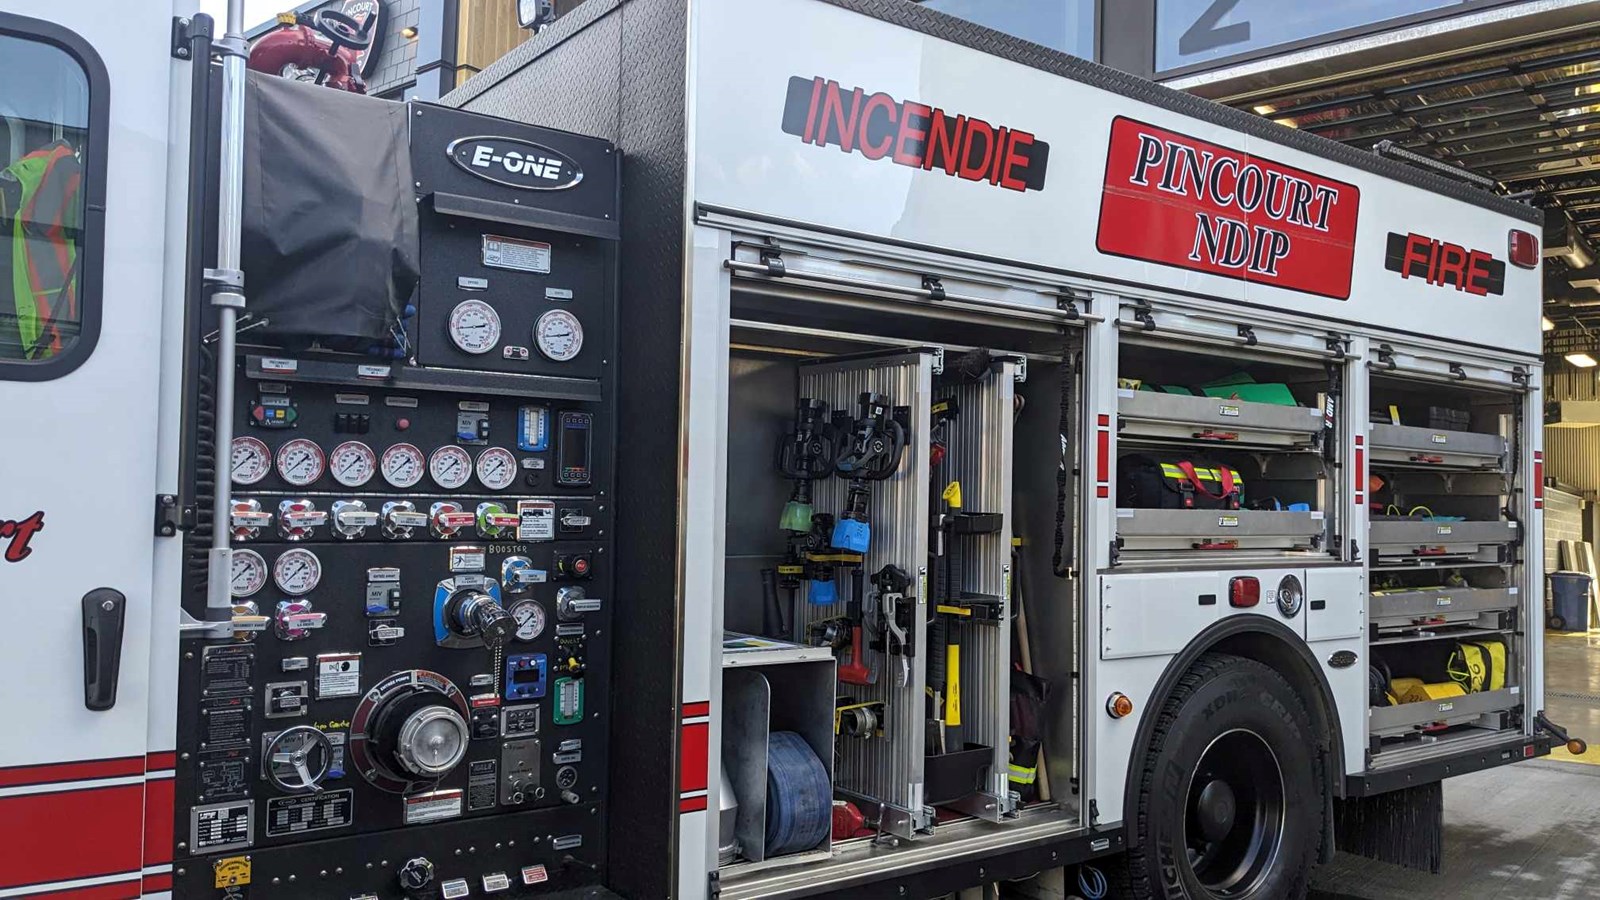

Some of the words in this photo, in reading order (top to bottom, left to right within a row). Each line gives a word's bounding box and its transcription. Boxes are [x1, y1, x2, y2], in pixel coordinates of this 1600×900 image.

[344, 2, 373, 17] INCOURT
[472, 145, 562, 180] E-ONE
[802, 76, 1035, 192] INCENDIE
[1130, 134, 1338, 232] PINCOURT
[1190, 213, 1290, 277] NDIP
[1401, 232, 1492, 296] FIRE
[489, 544, 528, 554] BOOSTER
